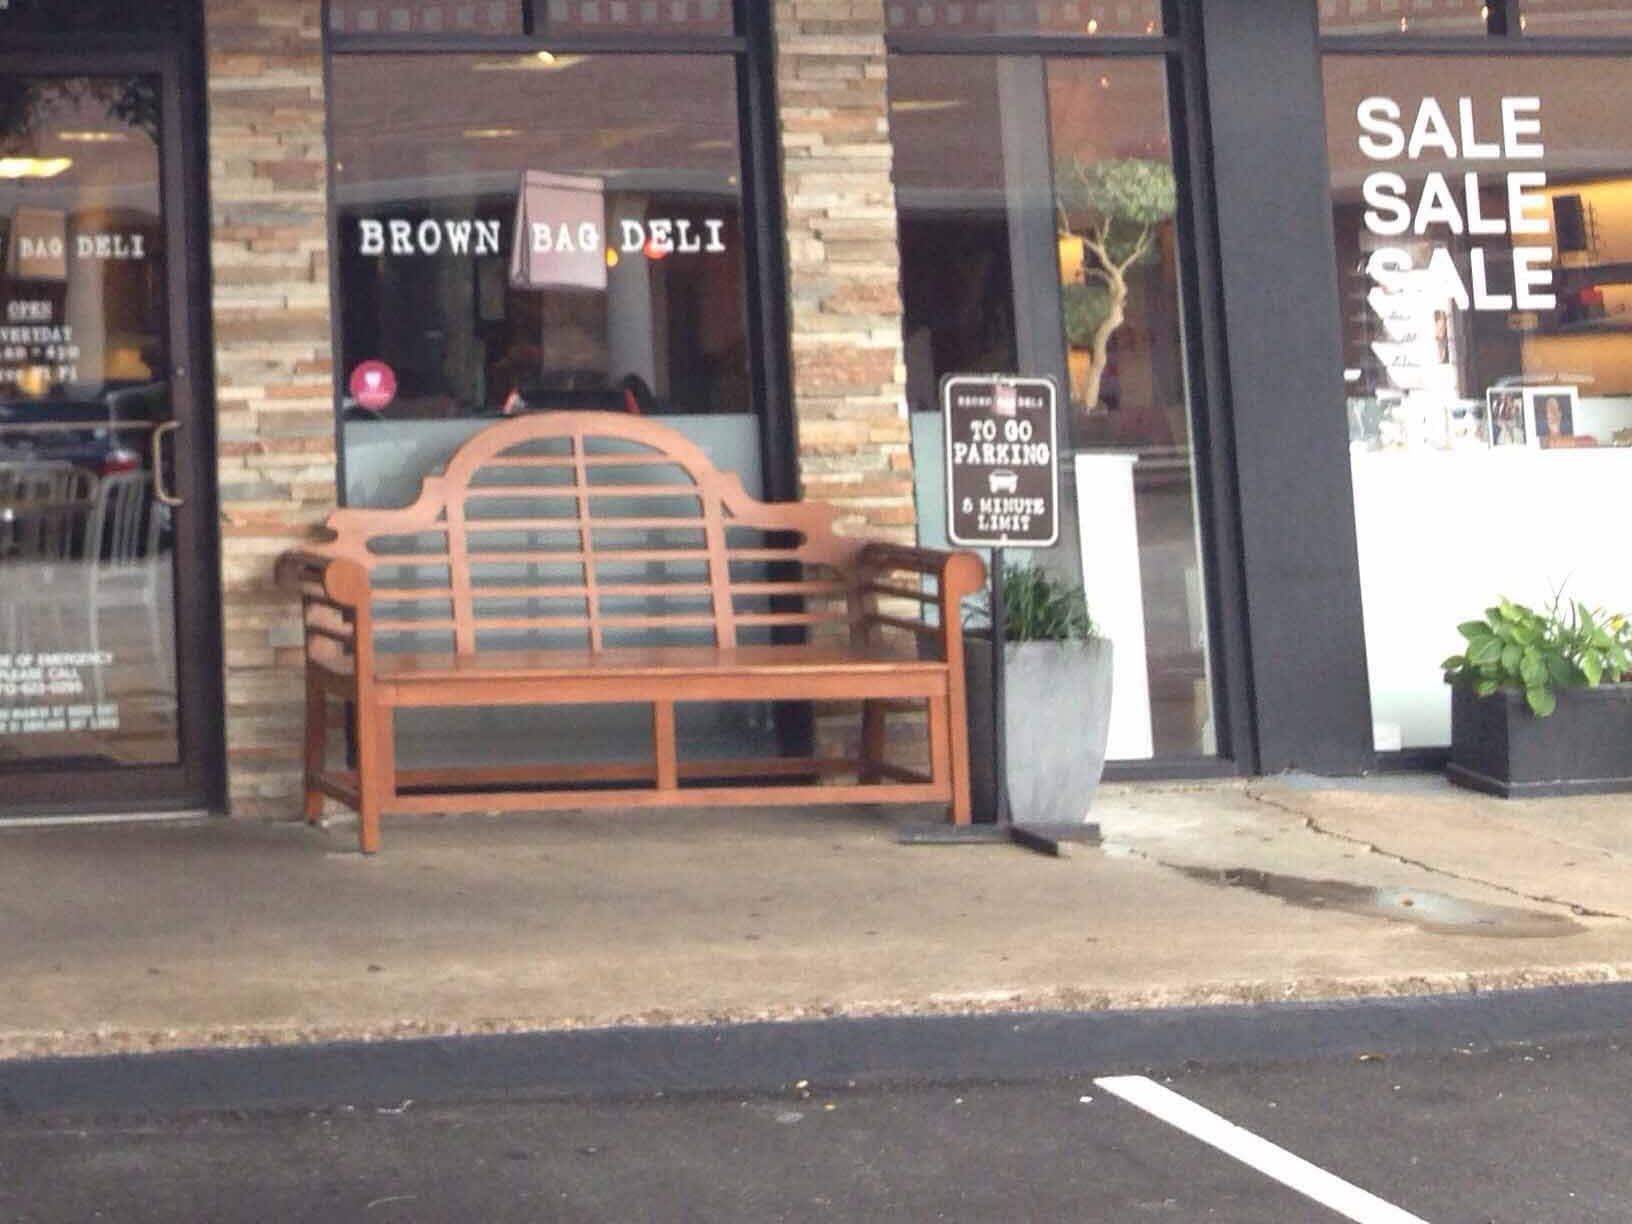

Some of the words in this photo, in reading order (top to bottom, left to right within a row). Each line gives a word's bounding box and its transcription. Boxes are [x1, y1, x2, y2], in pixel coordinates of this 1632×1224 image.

[1356, 96, 1545, 160] SALE
[1361, 171, 1553, 236] SALE
[19, 237, 64, 258] BAG
[76, 235, 145, 260] DELI
[359, 218, 502, 256] BROWN
[531, 222, 600, 253] BAG
[620, 218, 727, 253] DELI
[1366, 246, 1558, 311] SALE
[7, 300, 53, 321] OPEN
[969, 419, 996, 441] TO
[1004, 419, 1033, 442] GO
[953, 442, 1050, 466] PARKING
[979, 497, 1046, 516] MINUTE
[976, 514, 1032, 532] LIMIT
